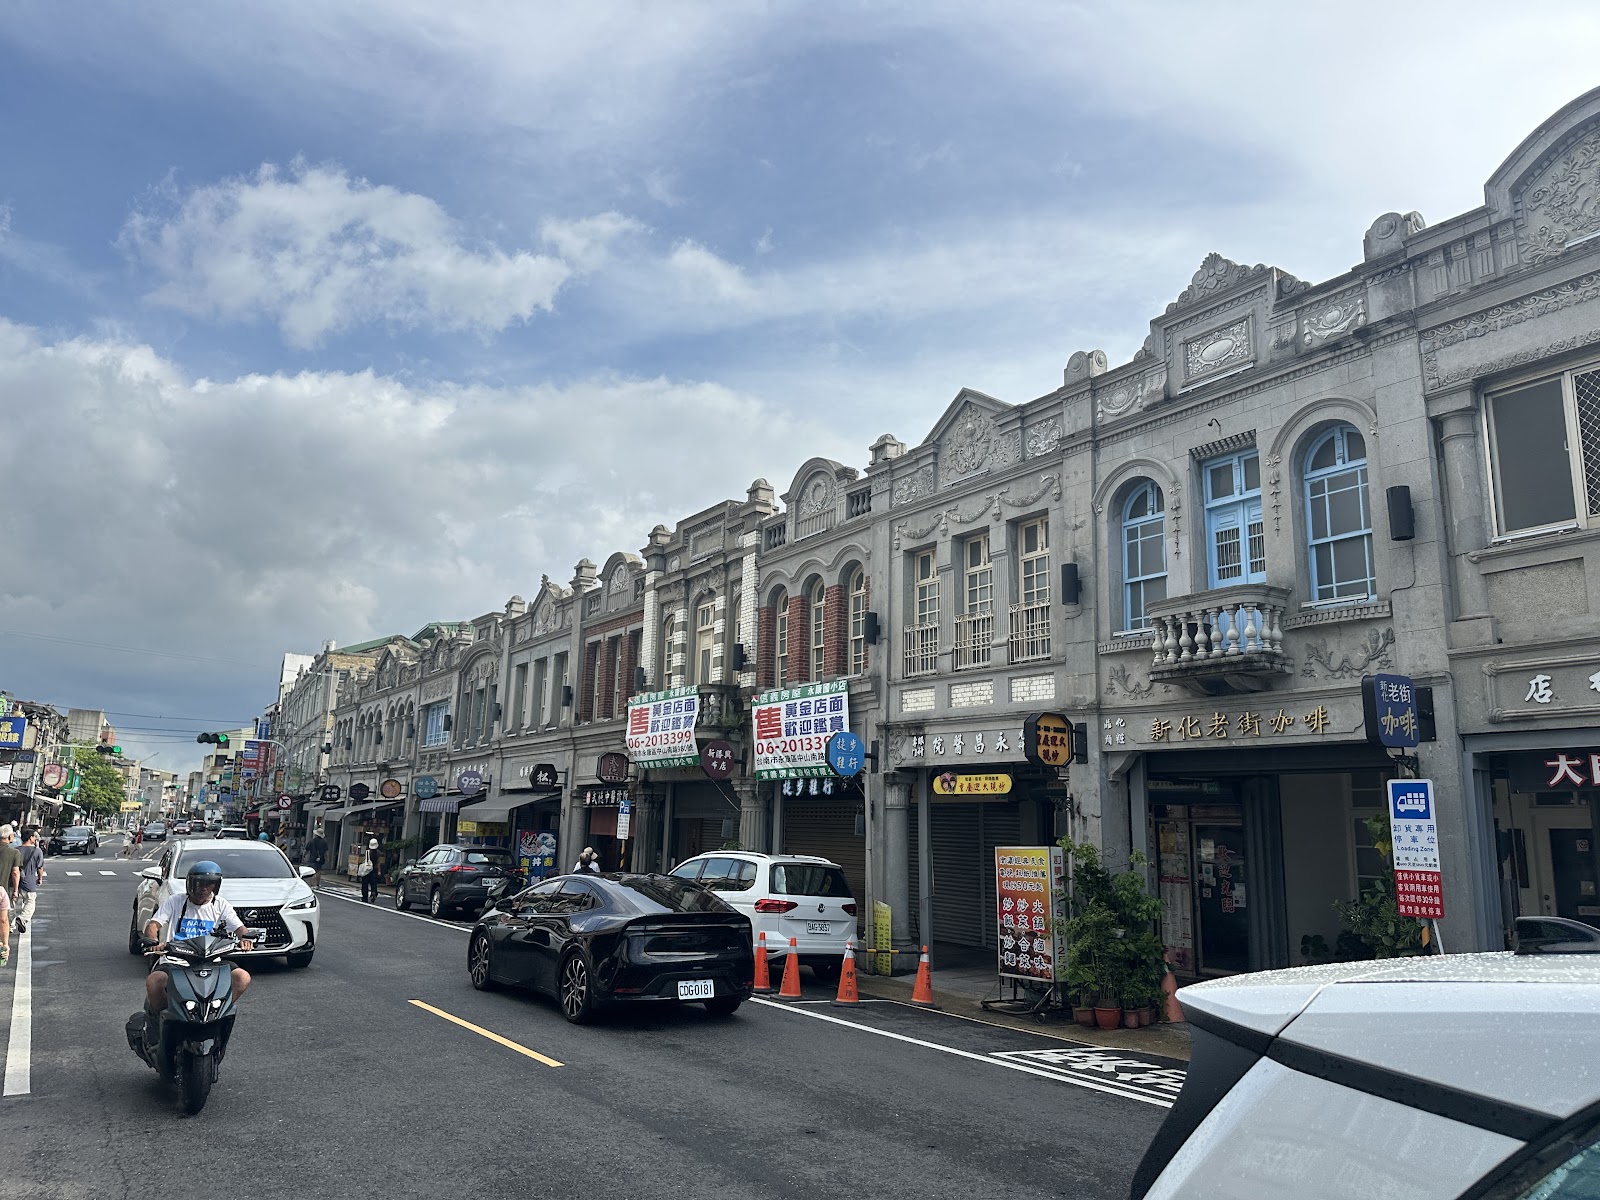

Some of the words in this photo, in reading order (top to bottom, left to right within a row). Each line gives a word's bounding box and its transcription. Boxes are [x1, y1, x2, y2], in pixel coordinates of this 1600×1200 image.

[760, 688, 801, 704] 信義房屋
[1388, 682, 1411, 704] 老街
[652, 698, 695, 717] 黃金店面
[785, 695, 843, 718] 黃金店面
[629, 707, 650, 736] 售
[650, 715, 695, 733] 歡迎鑑賞
[755, 707, 782, 740] 售
[784, 716, 844, 737] 歡迎鑑賞
[1150, 704, 1331, 743] 新化老街咖啡
[1381, 706, 1417, 741] 咖啡
[628, 730, 692, 749] 06-2013399
[836, 738, 857, 752] 徒步
[461, 776, 481, 788] 923
[1393, 824, 1435, 833] 卸貨專用
[1394, 835, 1435, 844] 停車位
